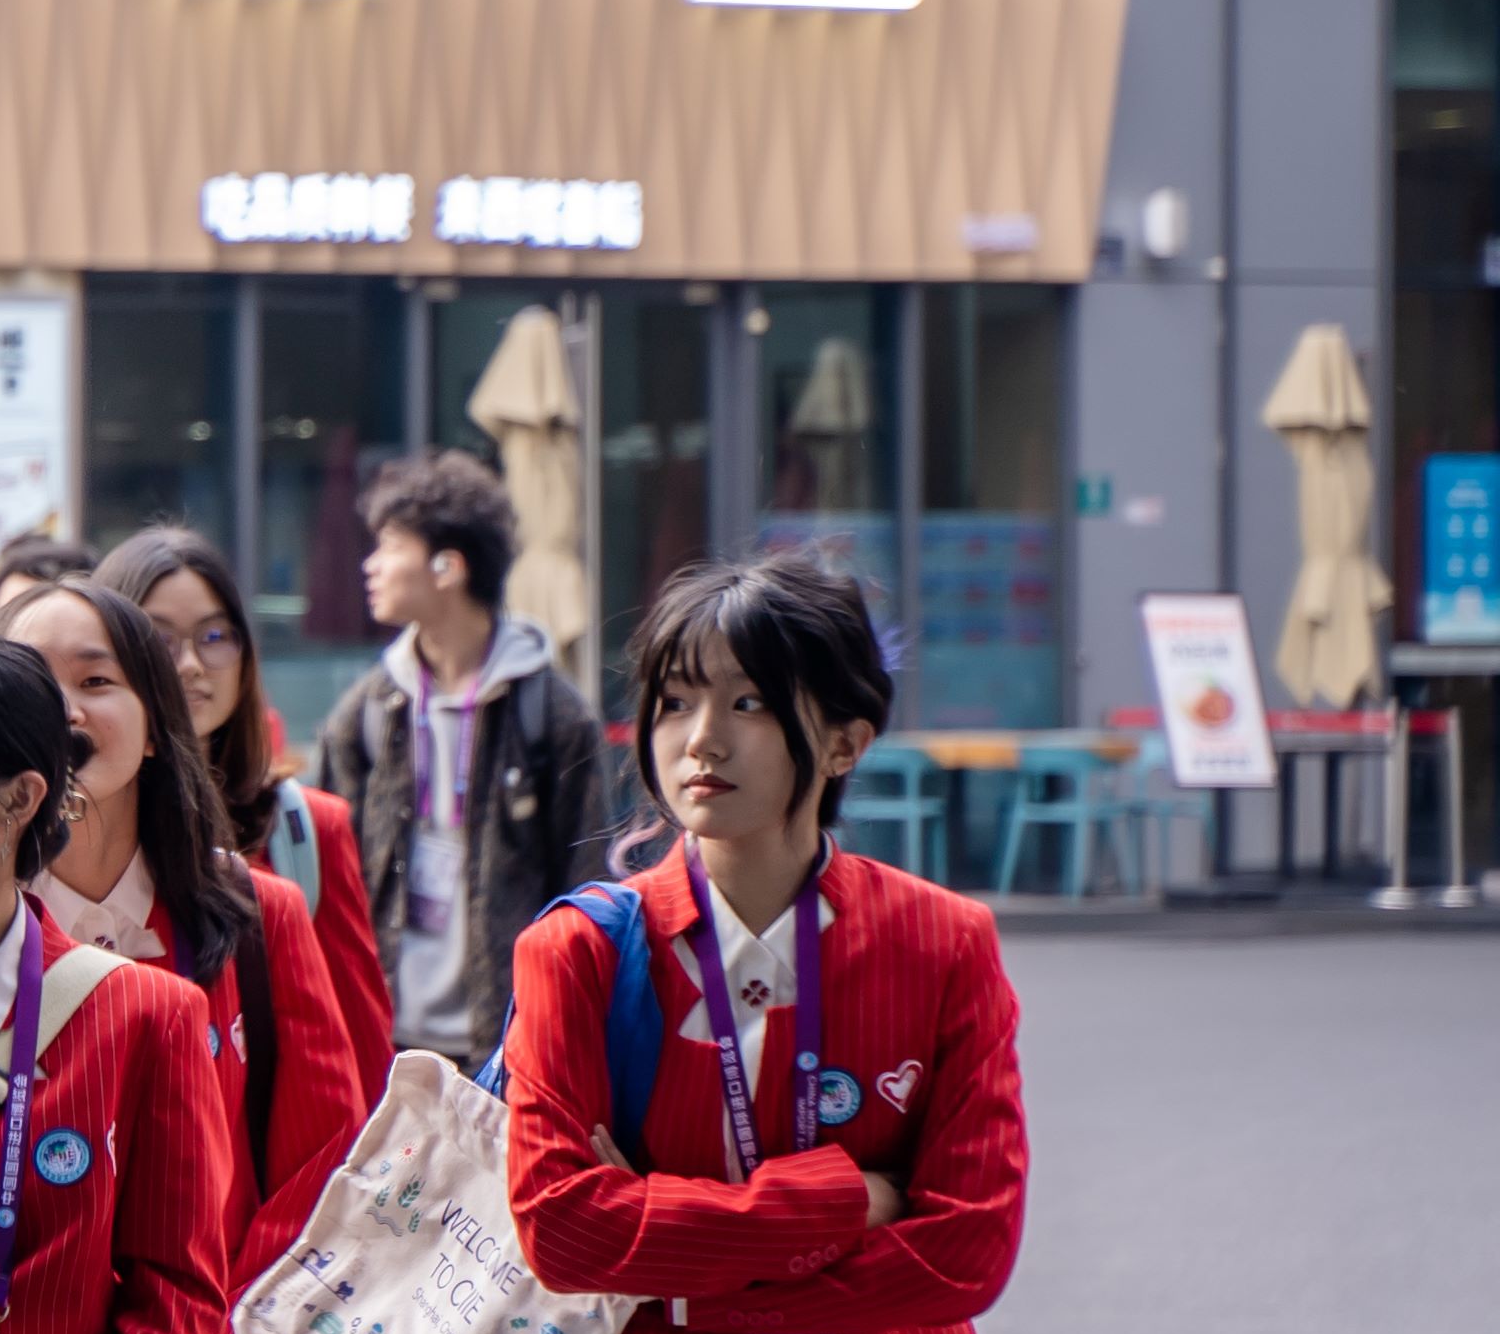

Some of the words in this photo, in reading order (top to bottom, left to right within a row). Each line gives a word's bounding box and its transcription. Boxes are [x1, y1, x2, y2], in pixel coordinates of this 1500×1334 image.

[430, 1252, 455, 1290] TO
[450, 1279, 485, 1326] CIIE
[440, 1199, 523, 1296] WELCOME
